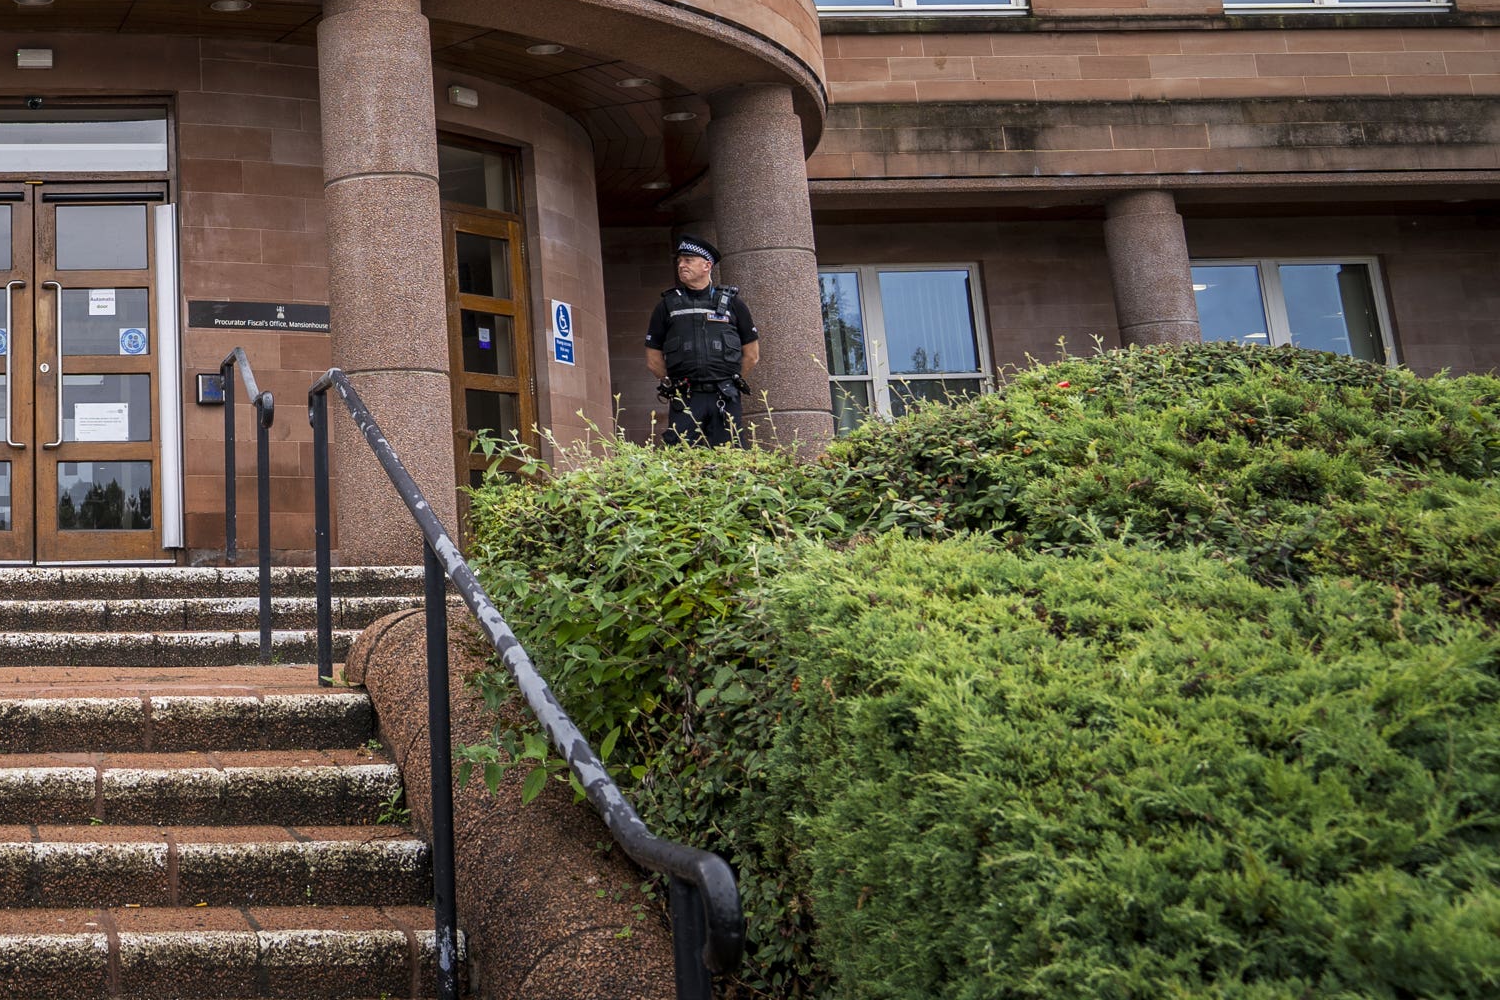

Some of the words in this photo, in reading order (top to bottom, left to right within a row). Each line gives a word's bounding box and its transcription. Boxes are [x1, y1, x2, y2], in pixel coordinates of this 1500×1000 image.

[214, 318, 246, 326] Procurator
[247, 319, 269, 327] Fiscal's
[289, 321, 328, 329] Mansionhouse
